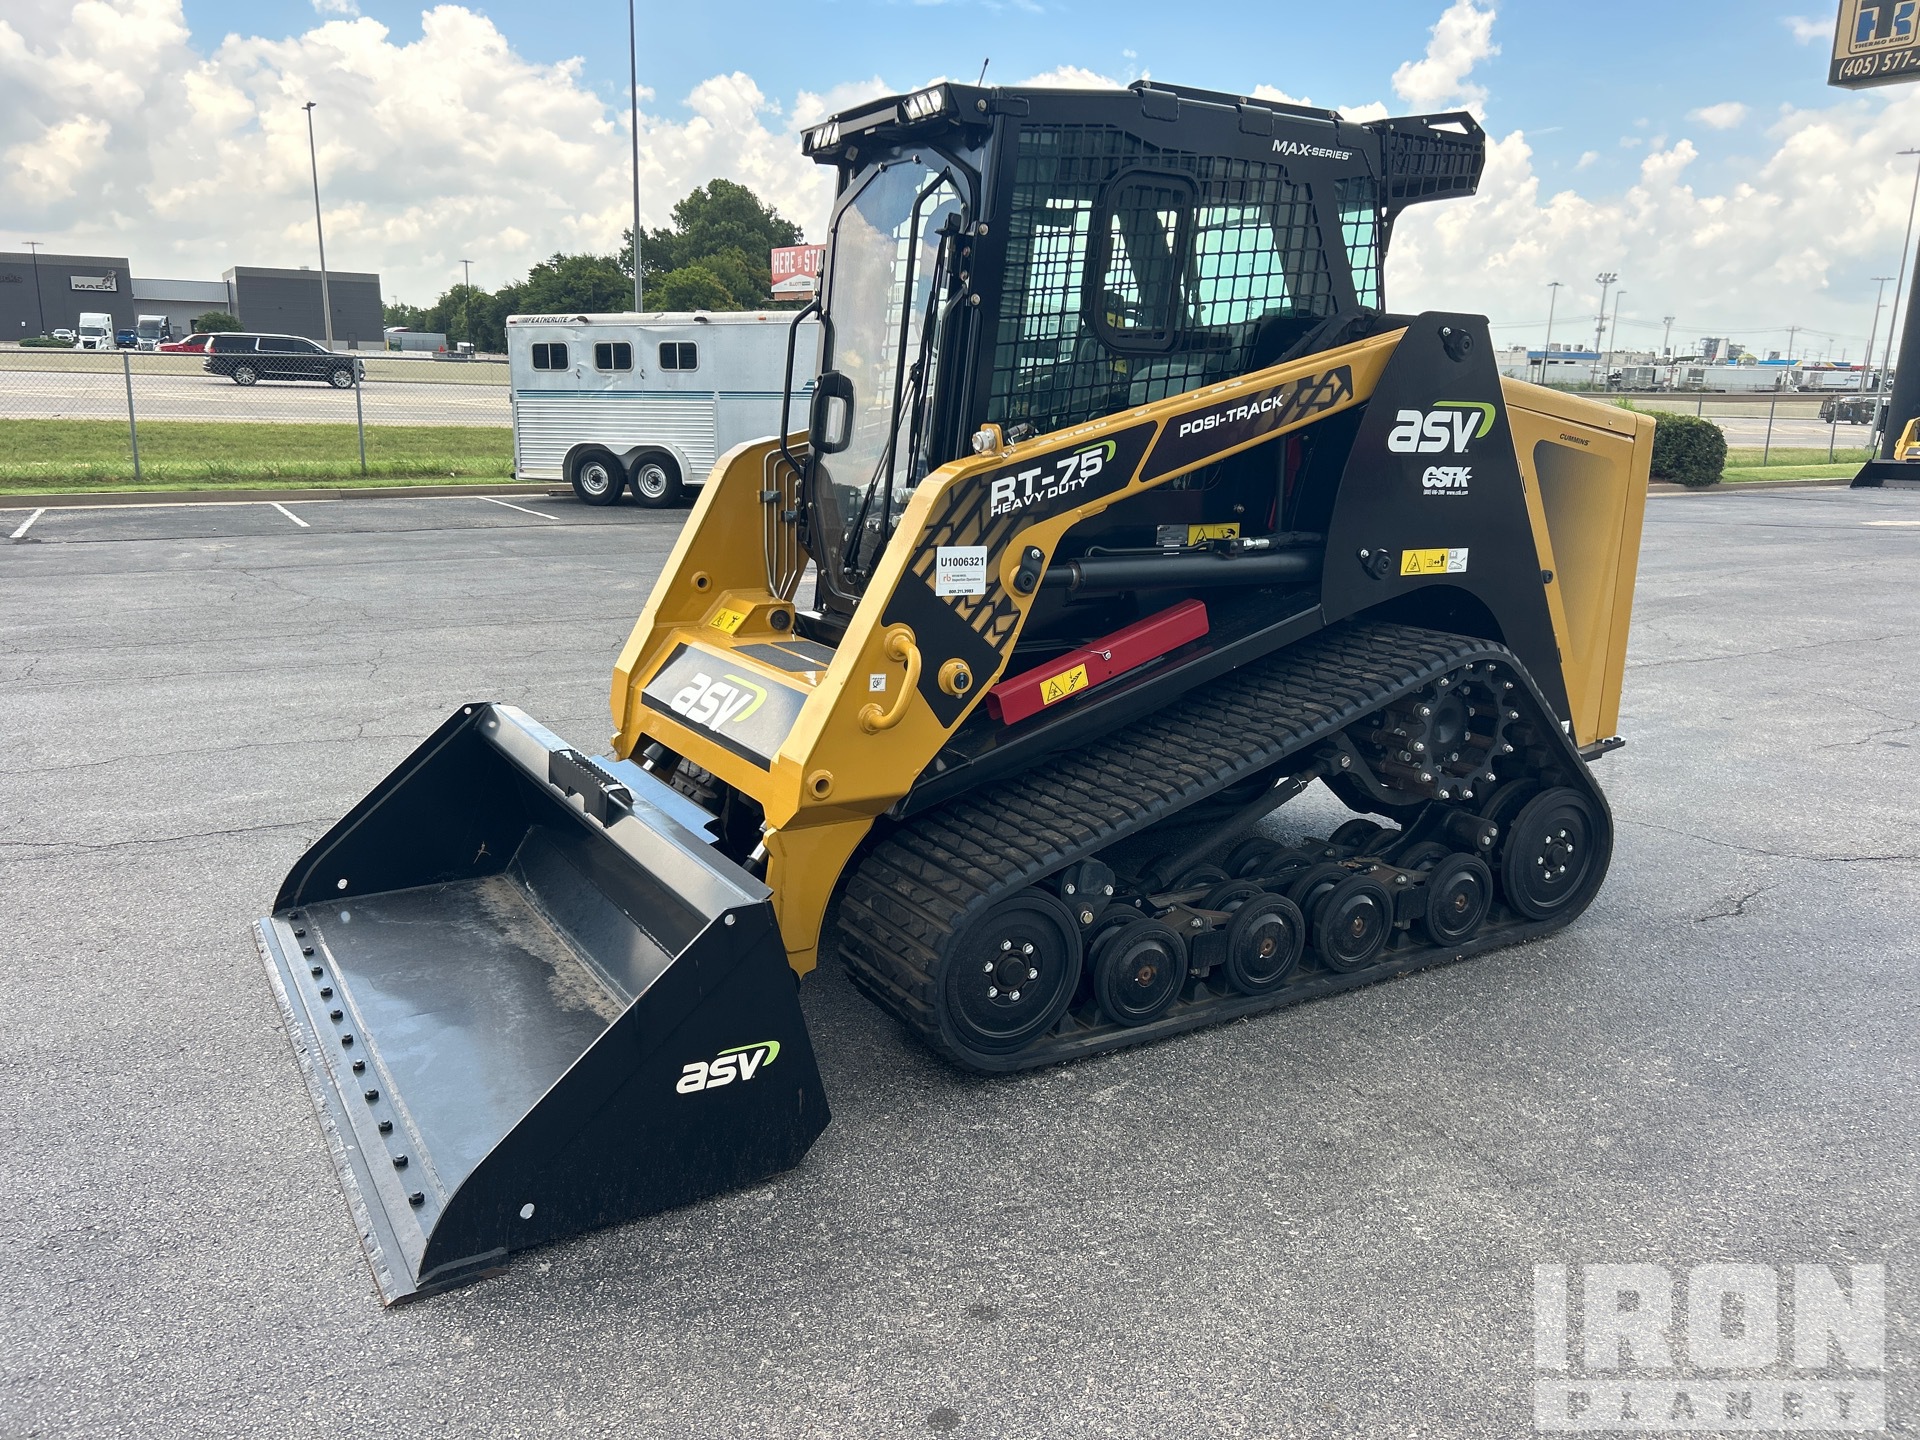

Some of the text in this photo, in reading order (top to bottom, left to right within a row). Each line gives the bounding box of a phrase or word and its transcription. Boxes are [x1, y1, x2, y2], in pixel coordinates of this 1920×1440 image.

[1855, 35, 1910, 49] THERMO KING
[1839, 50, 1920, 80] (405) 577-
[1272, 139, 1350, 160] MAX-SERIES
[773, 251, 796, 274] HERE
[527, 316, 568, 324] FEATHERLITE
[1179, 394, 1284, 438] POSI-TRACK
[1559, 433, 1590, 446] CUMMINS
[990, 447, 1103, 509] RT-75
[990, 476, 1089, 517] HEAVY DUTY
[941, 556, 984, 567] U1006321
